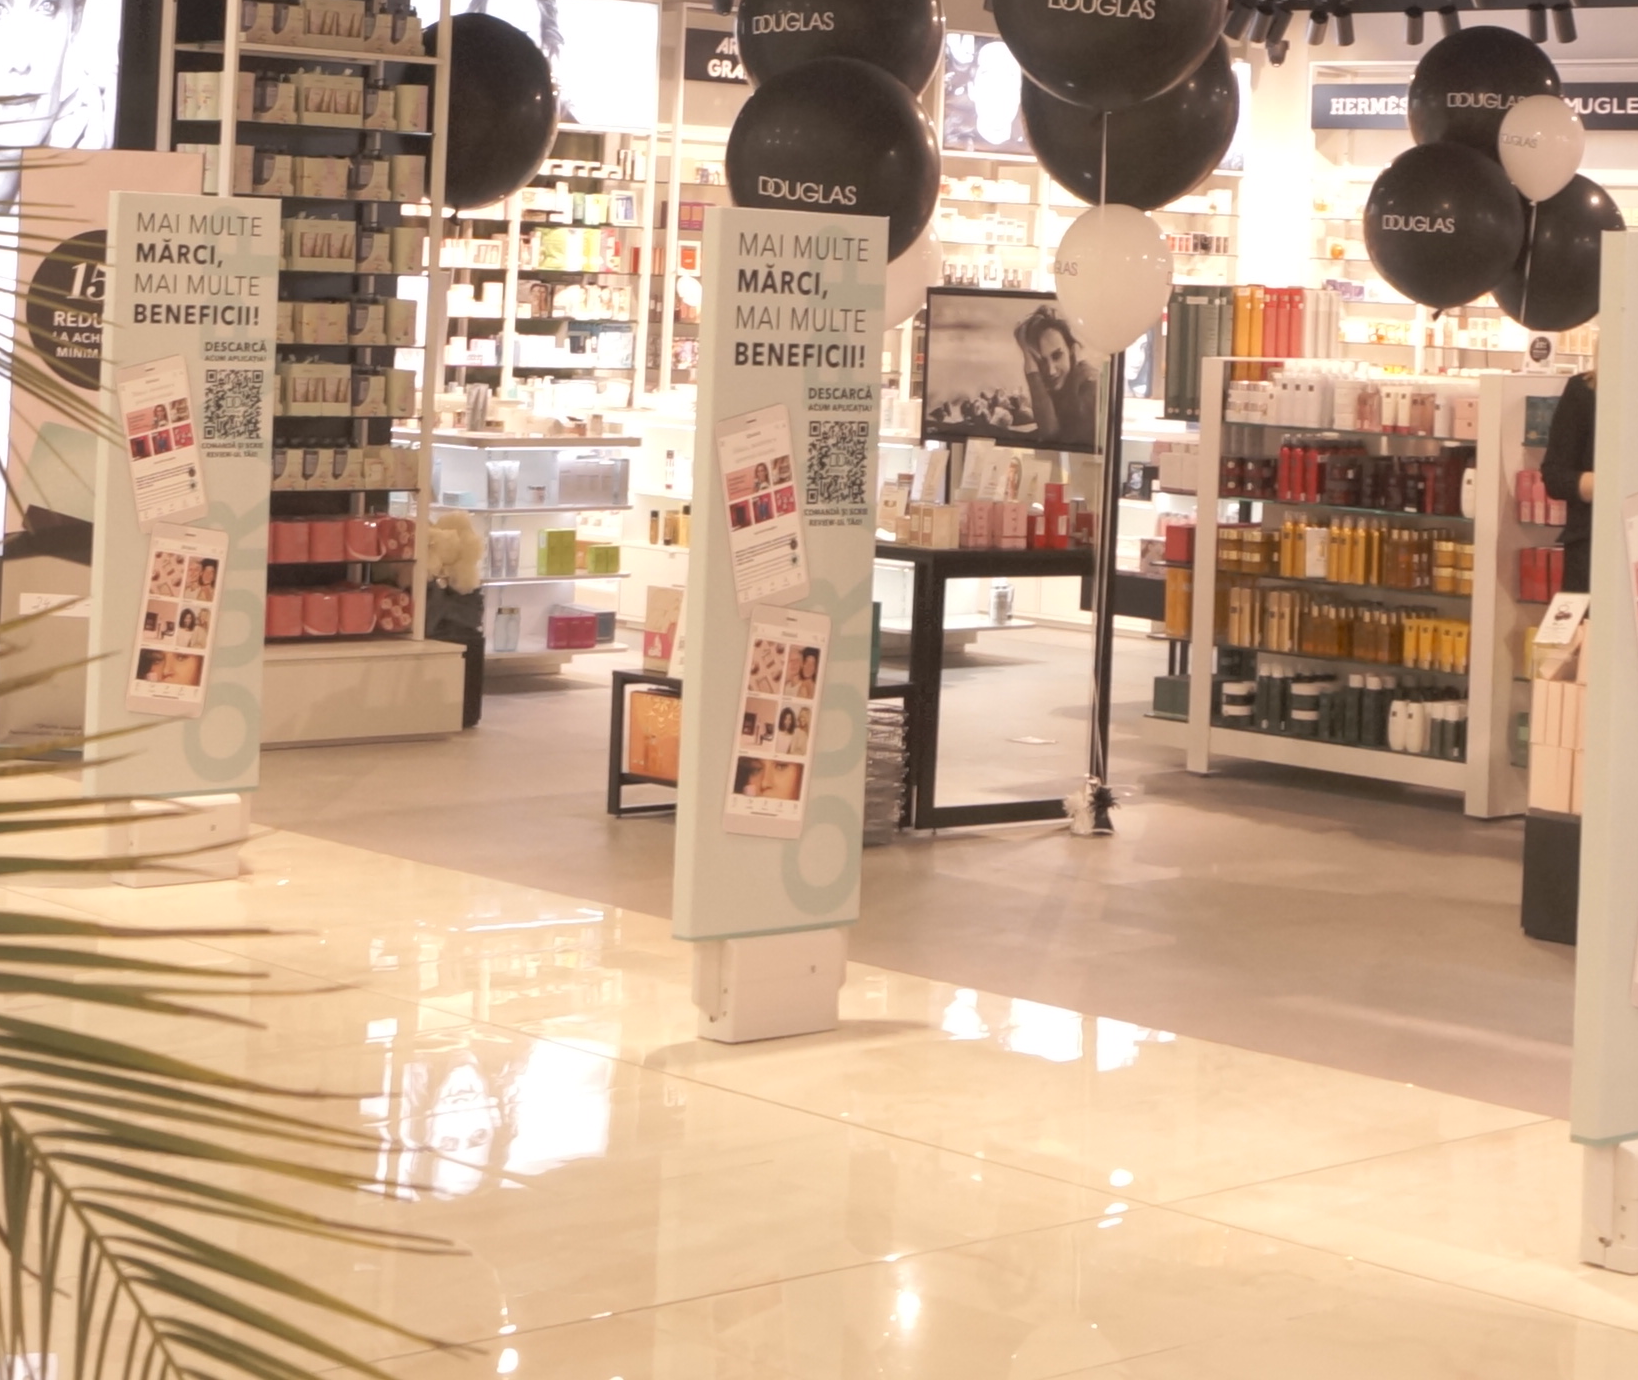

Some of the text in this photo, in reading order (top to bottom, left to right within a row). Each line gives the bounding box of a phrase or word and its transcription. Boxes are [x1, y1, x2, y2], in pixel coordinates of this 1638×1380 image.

[752, 11, 834, 35] DOUGLAS
[758, 175, 857, 206] DOUGLAS
[137, 212, 262, 237] MAI MULTE
[1382, 214, 1456, 234] DOUGLAS
[135, 238, 223, 268] MĂRCI,
[739, 232, 869, 262] MAI MULTE
[134, 273, 261, 297] MAI MULTE
[737, 263, 828, 300] MĂRCI,
[53, 311, 104, 328] REDU
[133, 304, 260, 326] BENEFICII!
[735, 305, 866, 333] MAI MULTE
[204, 340, 267, 352] DESCARCĂ
[734, 342, 866, 368] BENEFICII!
[808, 385, 873, 400] DESCARCĂ
